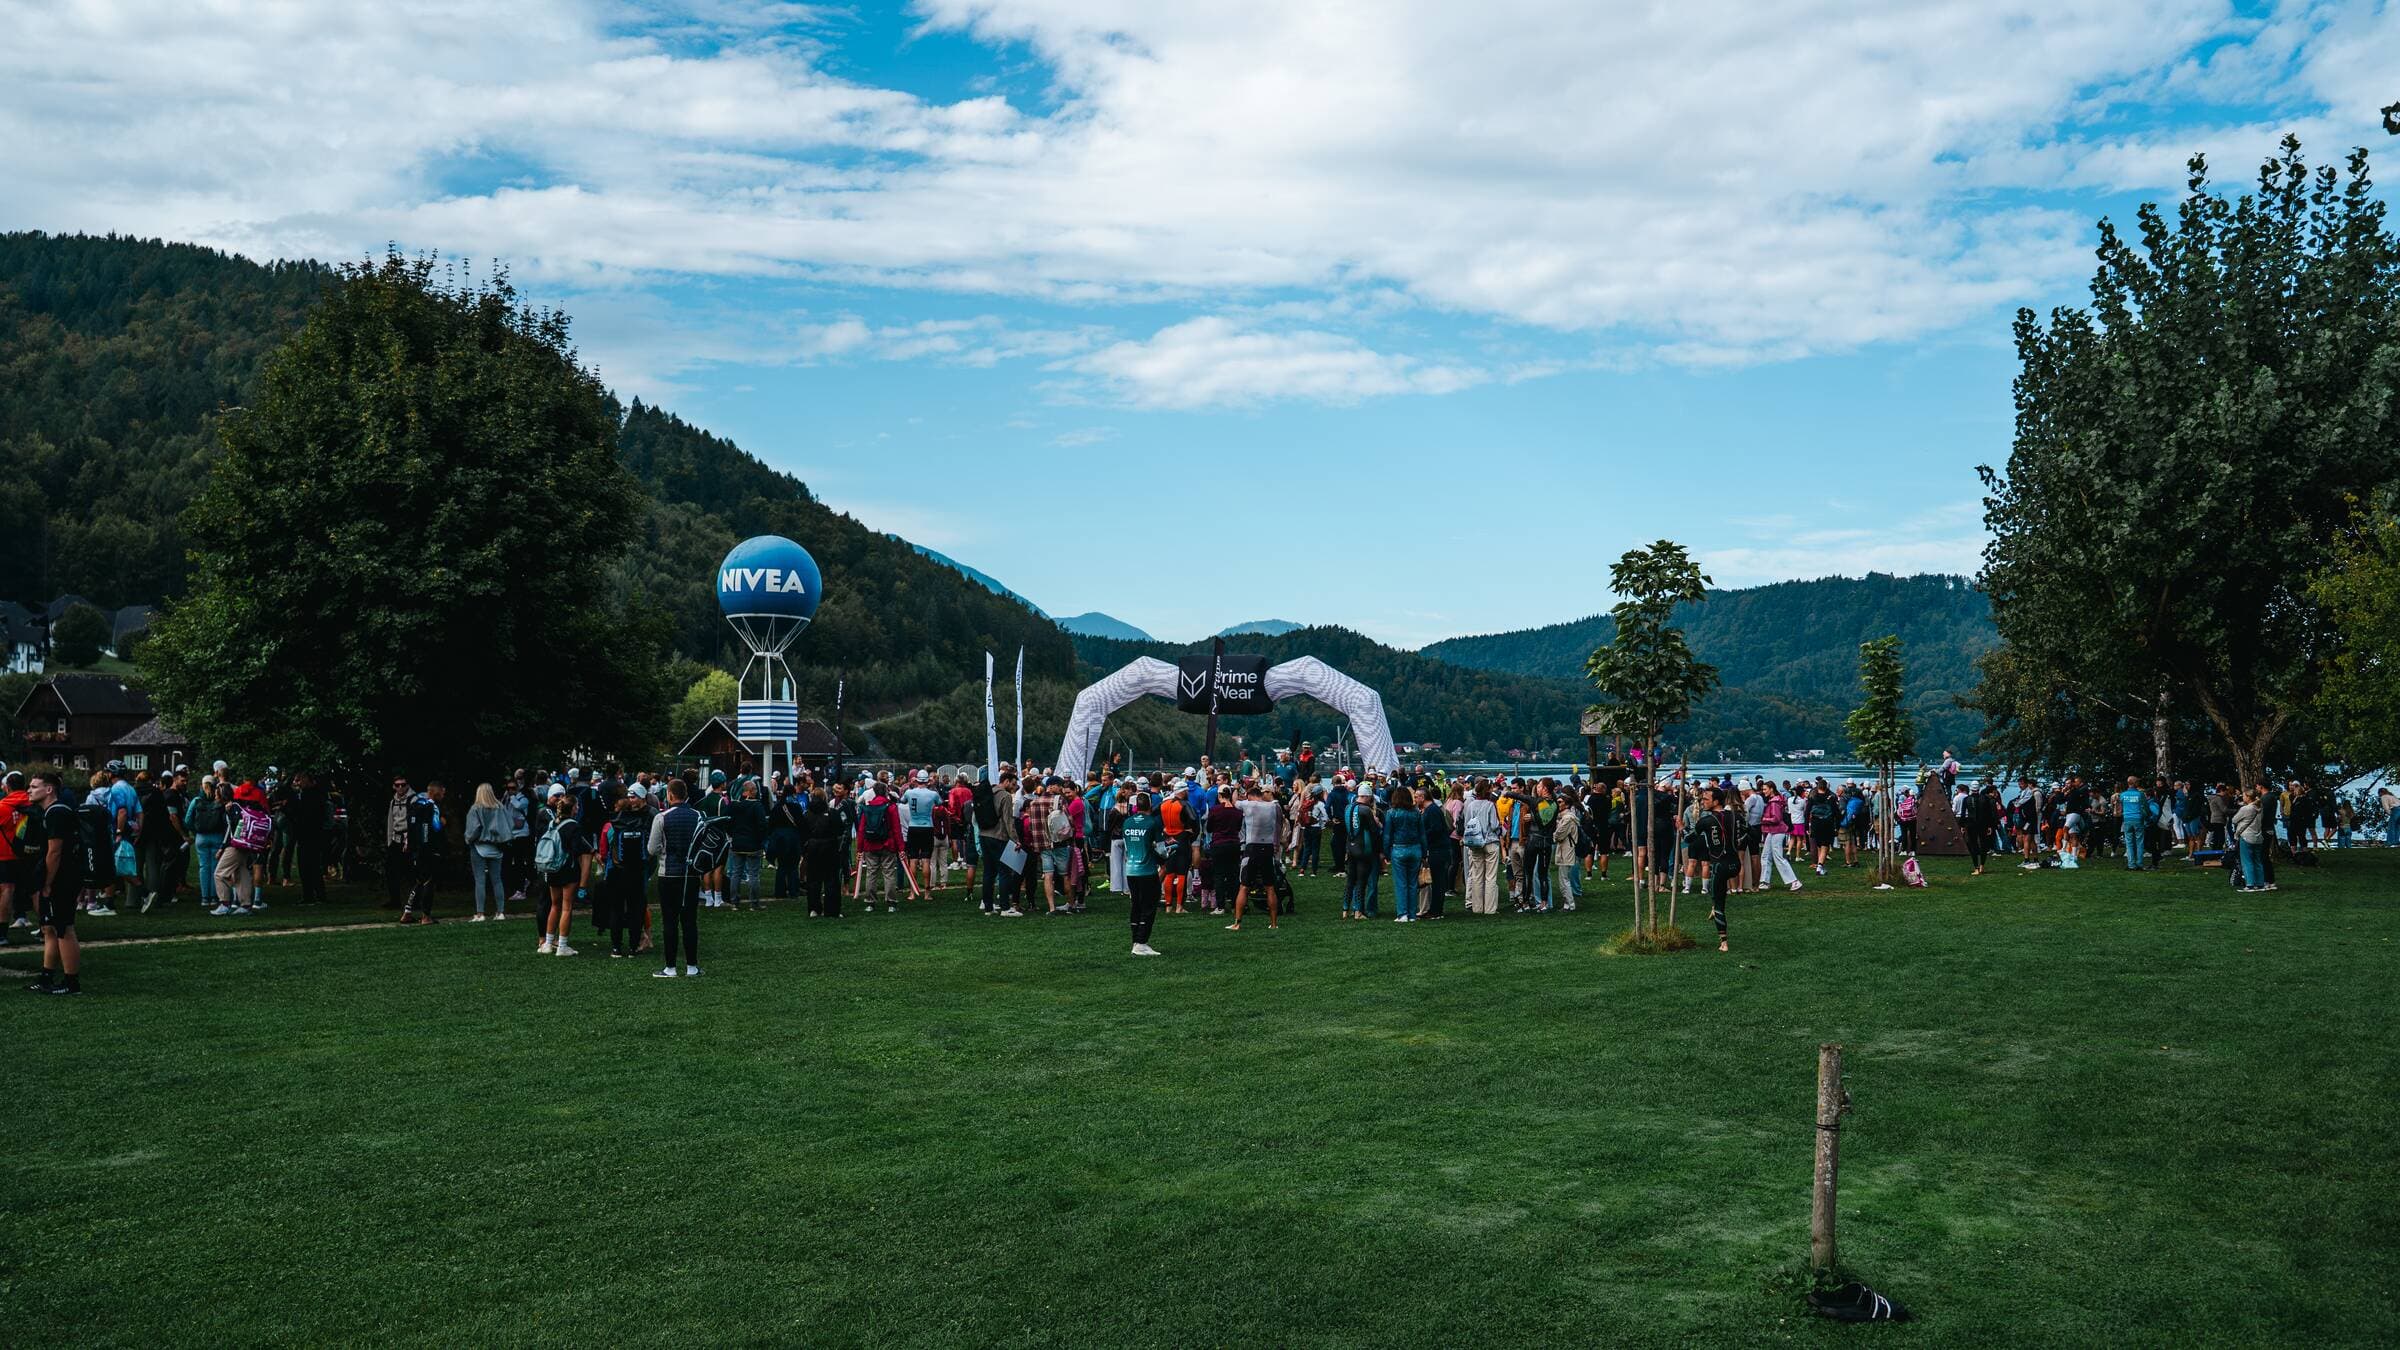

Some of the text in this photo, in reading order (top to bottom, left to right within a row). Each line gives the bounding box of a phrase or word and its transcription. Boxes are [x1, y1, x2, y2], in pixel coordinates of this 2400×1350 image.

[722, 568, 805, 593] NIVEA
[1220, 669, 1258, 684] rime
[1124, 829, 1147, 837] CREW
